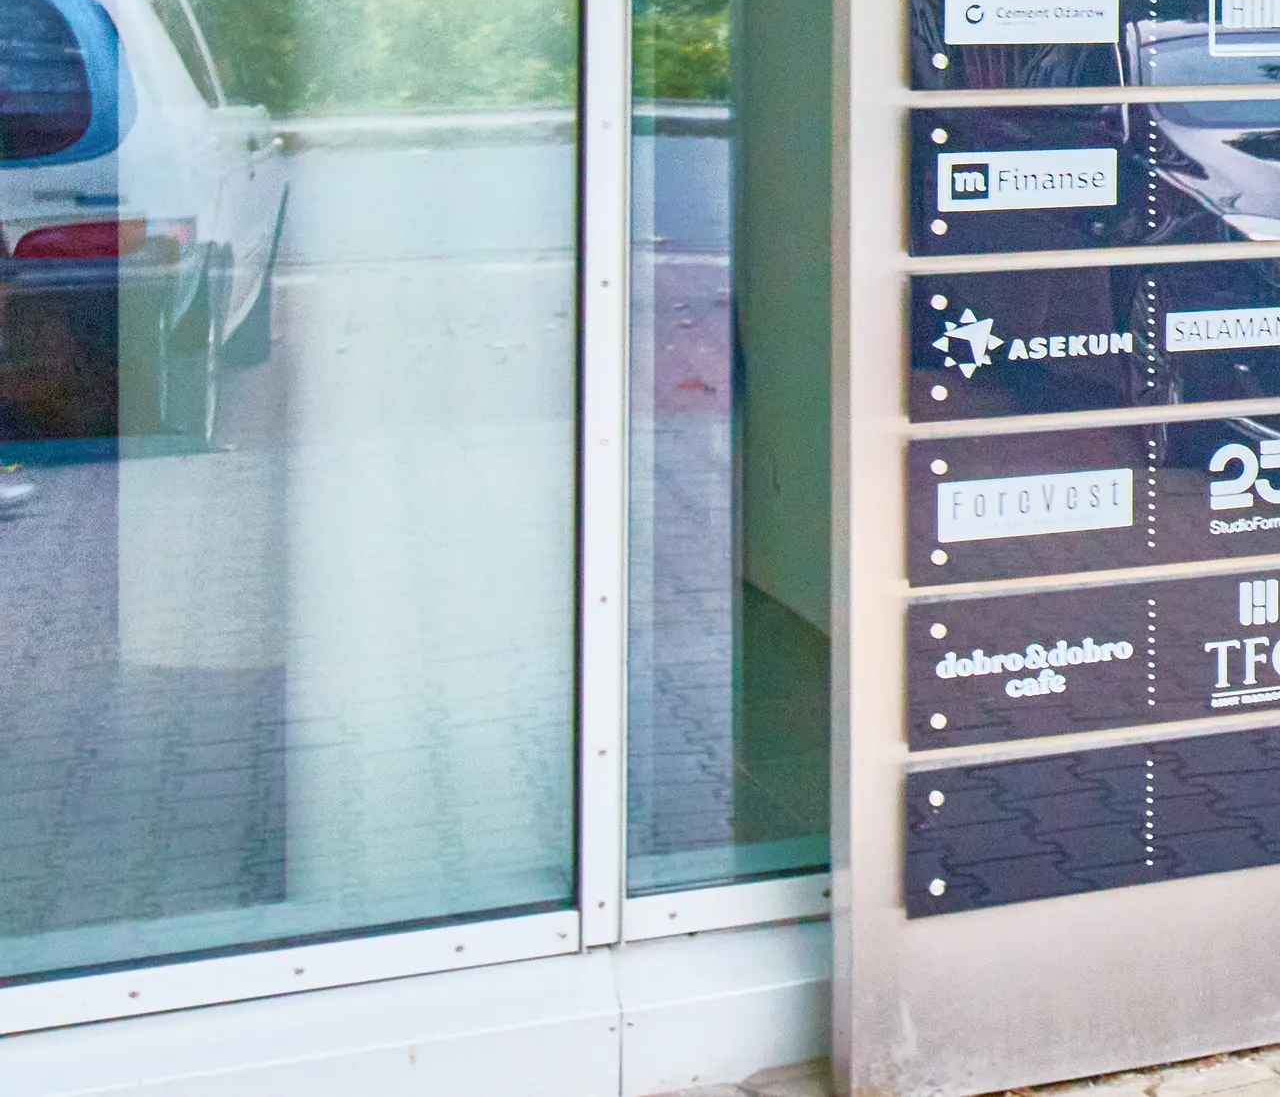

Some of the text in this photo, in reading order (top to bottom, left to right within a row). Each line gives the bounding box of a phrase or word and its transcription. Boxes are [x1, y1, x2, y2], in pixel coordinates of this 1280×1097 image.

[998, 168, 1107, 193] Finanse
[1008, 332, 1133, 360] ASEKUM
[952, 479, 1120, 520] ForeVest
[1005, 668, 1067, 698] cafe
